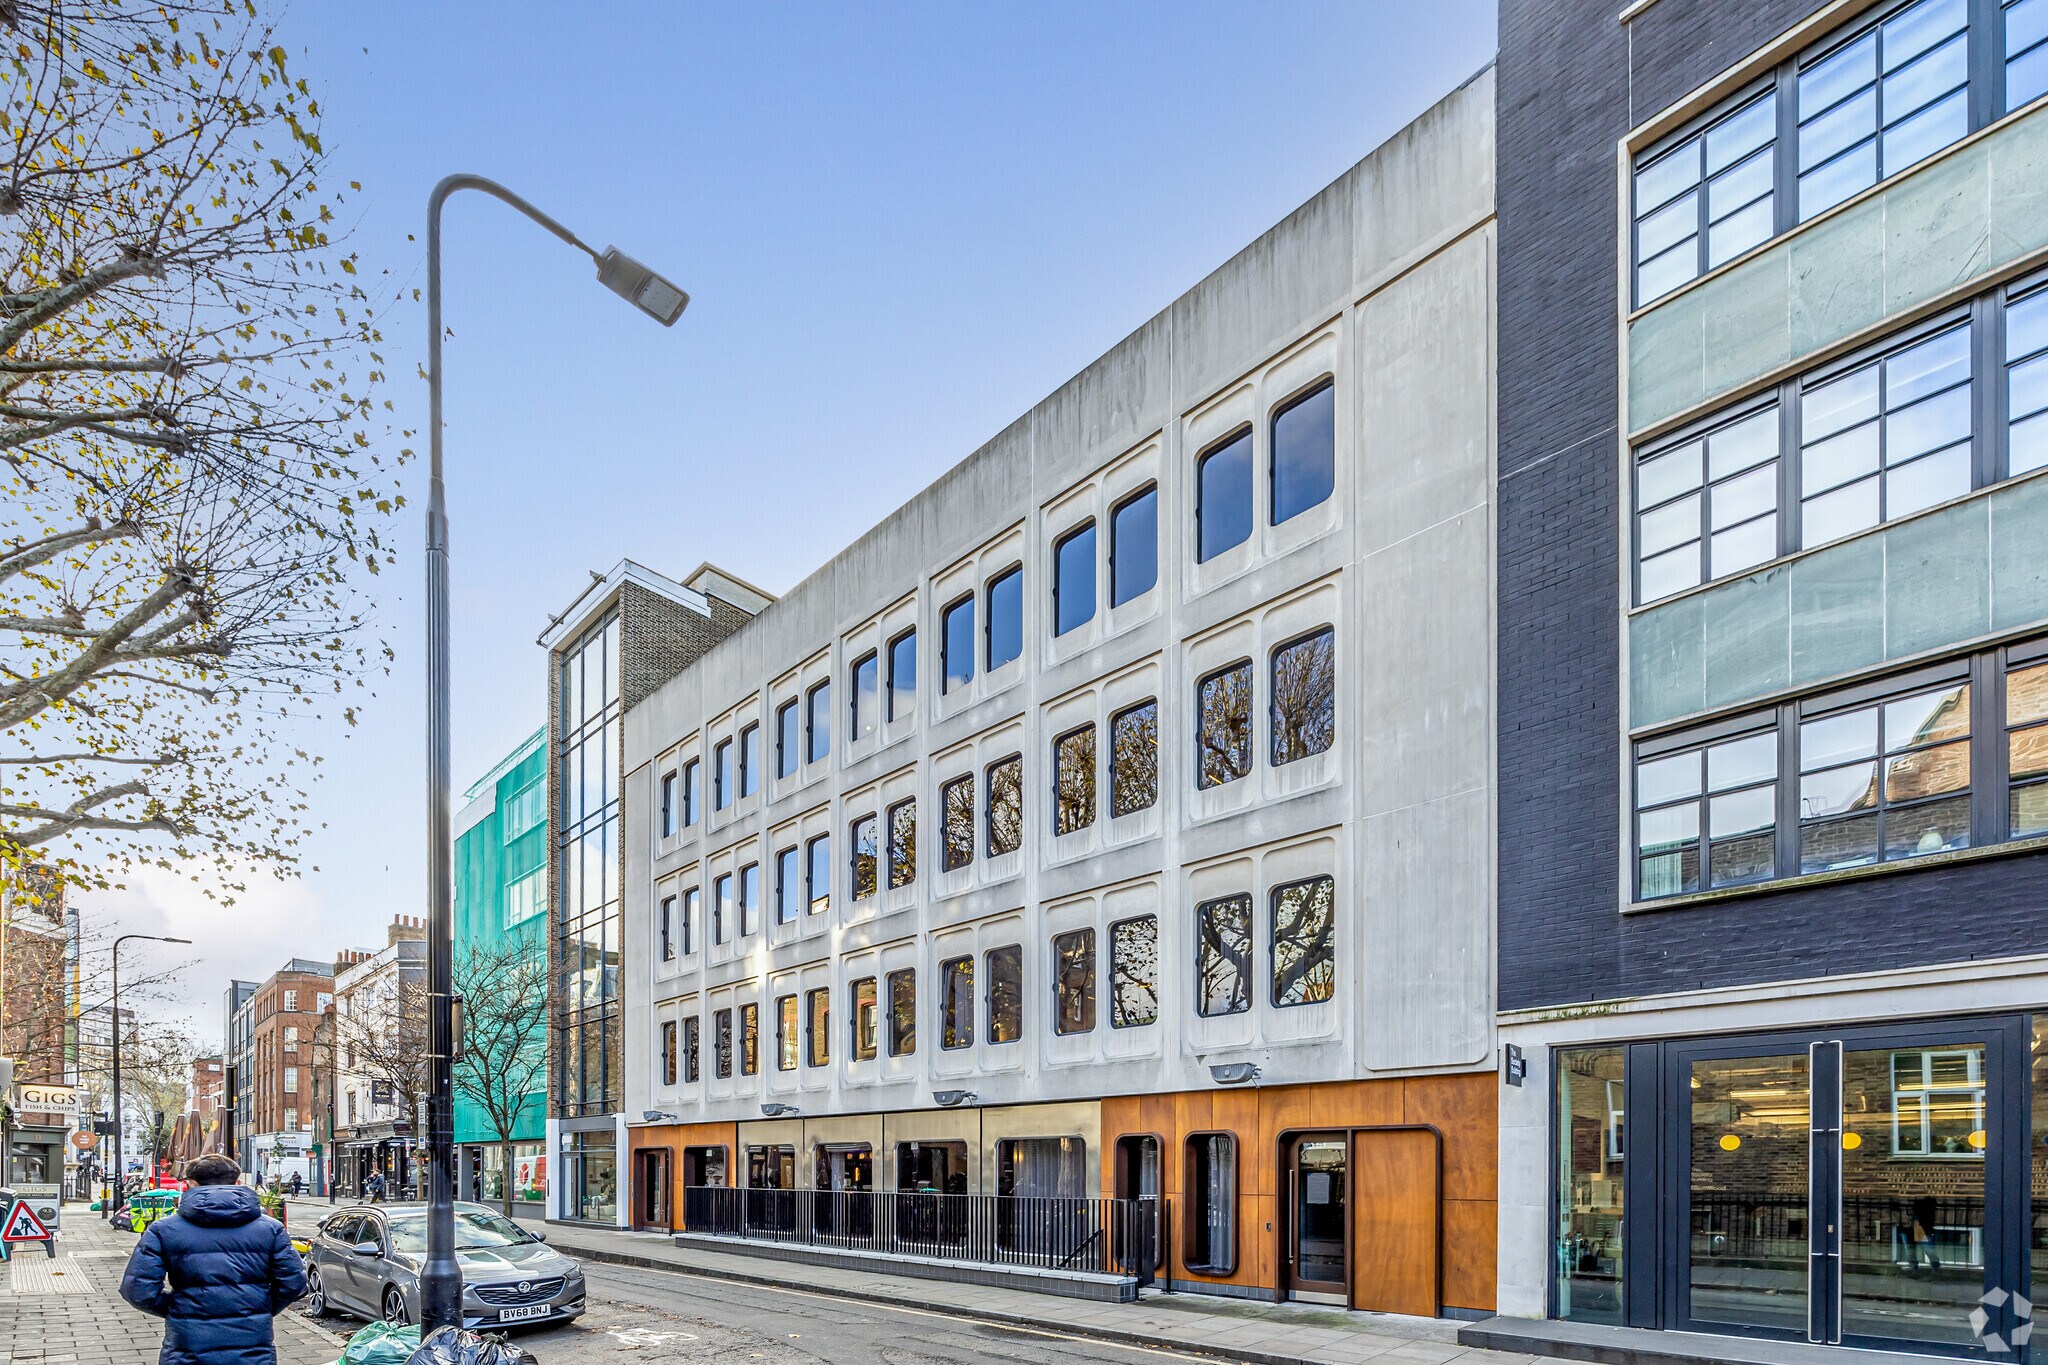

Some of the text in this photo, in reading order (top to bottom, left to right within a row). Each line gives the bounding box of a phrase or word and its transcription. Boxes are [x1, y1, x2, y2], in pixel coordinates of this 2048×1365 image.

[24, 1090, 77, 1105] GIGS
[503, 1305, 548, 1319] BV68 BNJ
